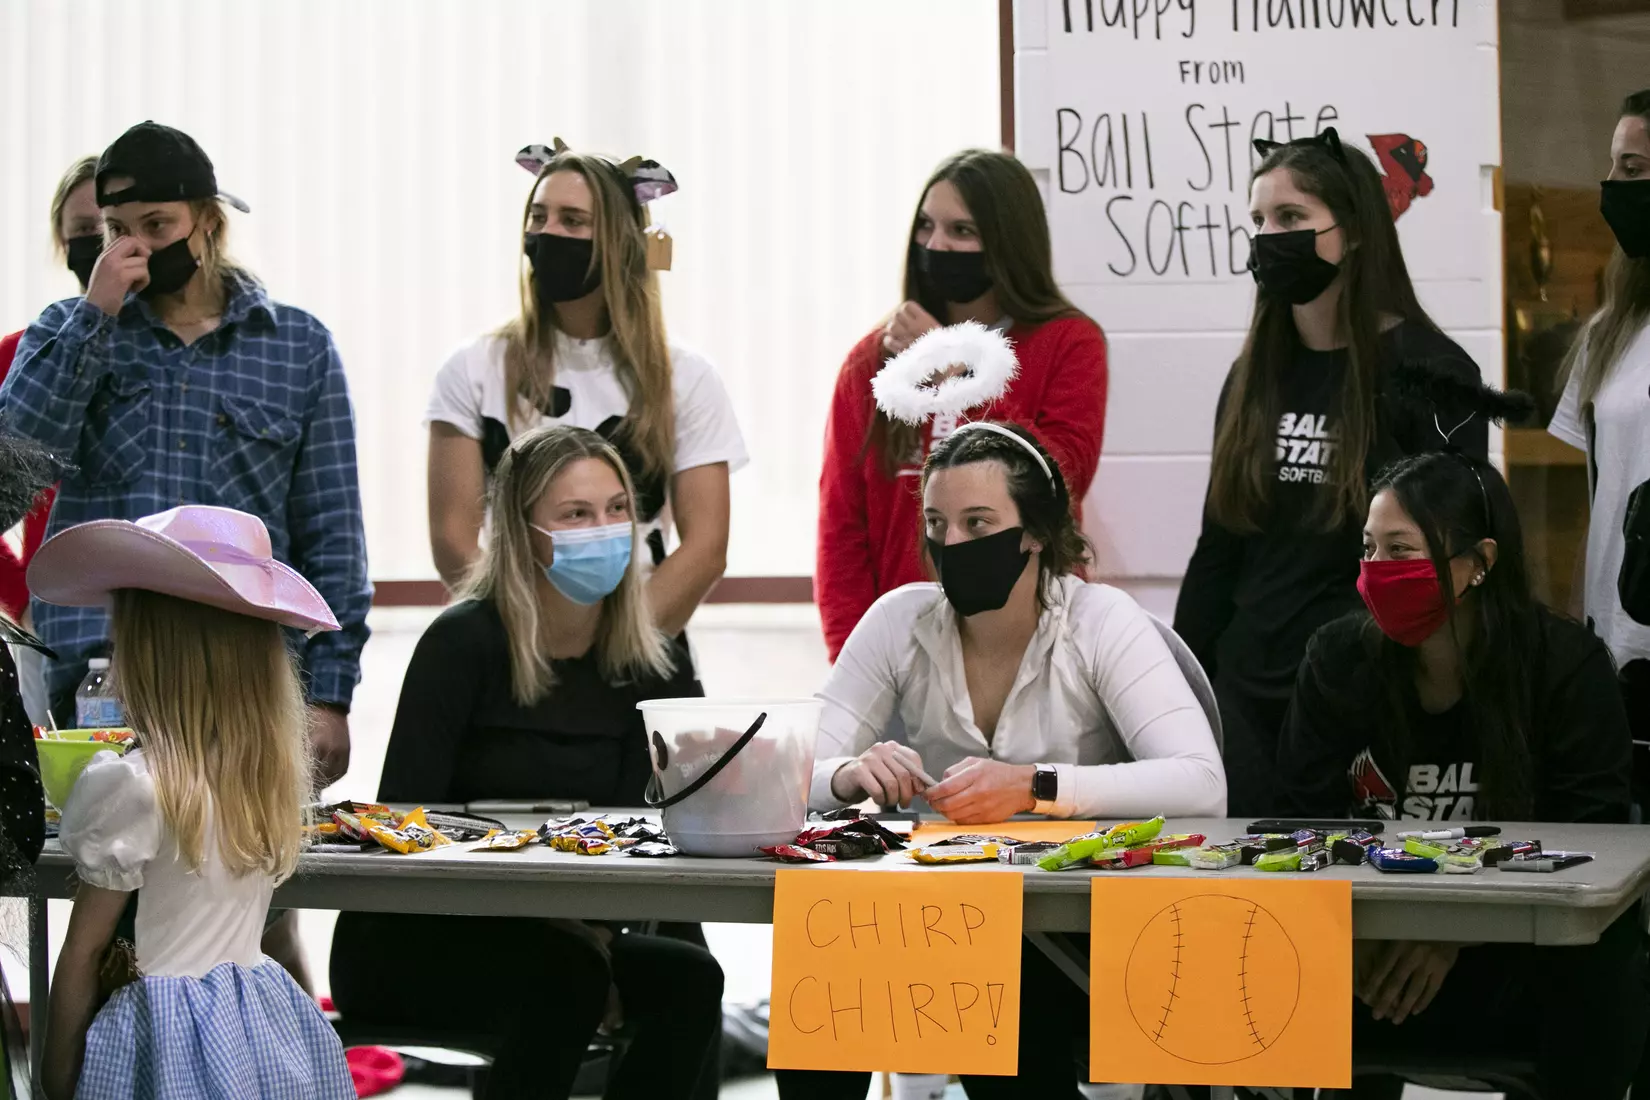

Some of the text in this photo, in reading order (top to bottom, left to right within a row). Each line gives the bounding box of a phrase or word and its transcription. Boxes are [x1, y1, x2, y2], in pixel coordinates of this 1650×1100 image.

[1179, 60, 1245, 84] From
[1057, 108, 1154, 194] Ball
[1106, 195, 1250, 277] Softb
[1277, 412, 1328, 438] BAL
[1276, 438, 1338, 466] STAT
[1278, 466, 1324, 484] SOFTB
[1406, 762, 1480, 794] BAL
[1401, 796, 1475, 821] STA
[806, 899, 985, 948] CHIRP
[789, 976, 1004, 1045] CHIRP!
